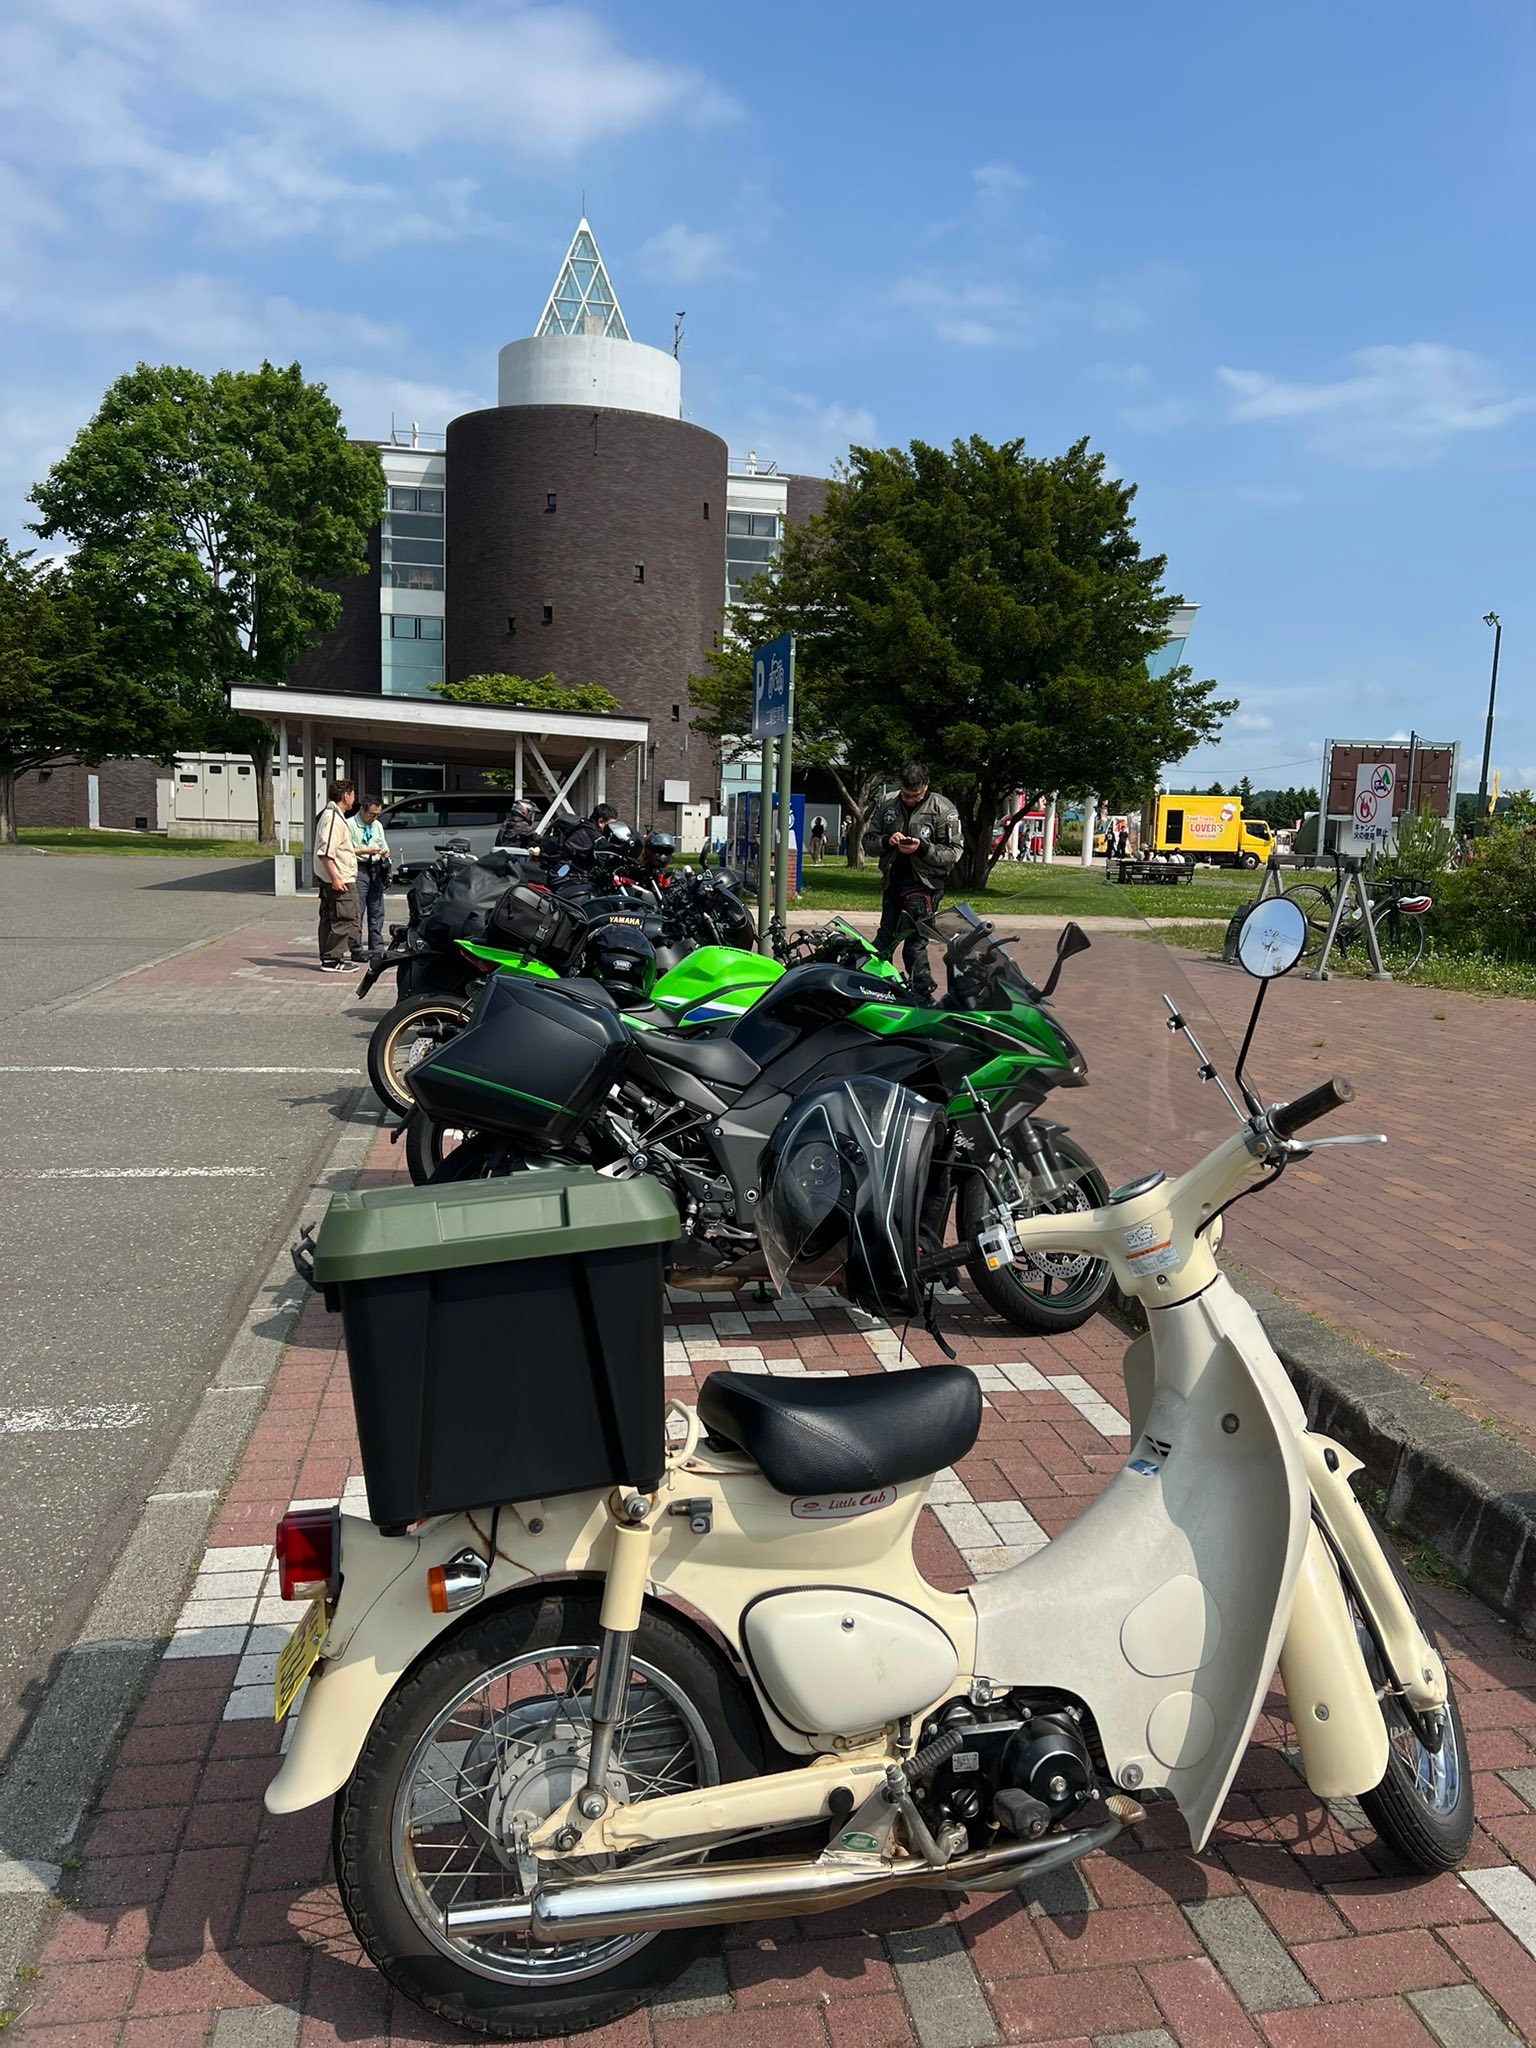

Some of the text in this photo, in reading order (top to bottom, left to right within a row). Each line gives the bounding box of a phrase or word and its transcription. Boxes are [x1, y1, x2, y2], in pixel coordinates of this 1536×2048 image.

[756, 660, 765, 730] P
[1190, 823, 1224, 833] LOVER'S
[1355, 824, 1376, 832] キャンプ
[1354, 832, 1375, 841] 火の使用
[609, 916, 640, 926] YAMAHA
[828, 1491, 886, 1509] Little Cub
